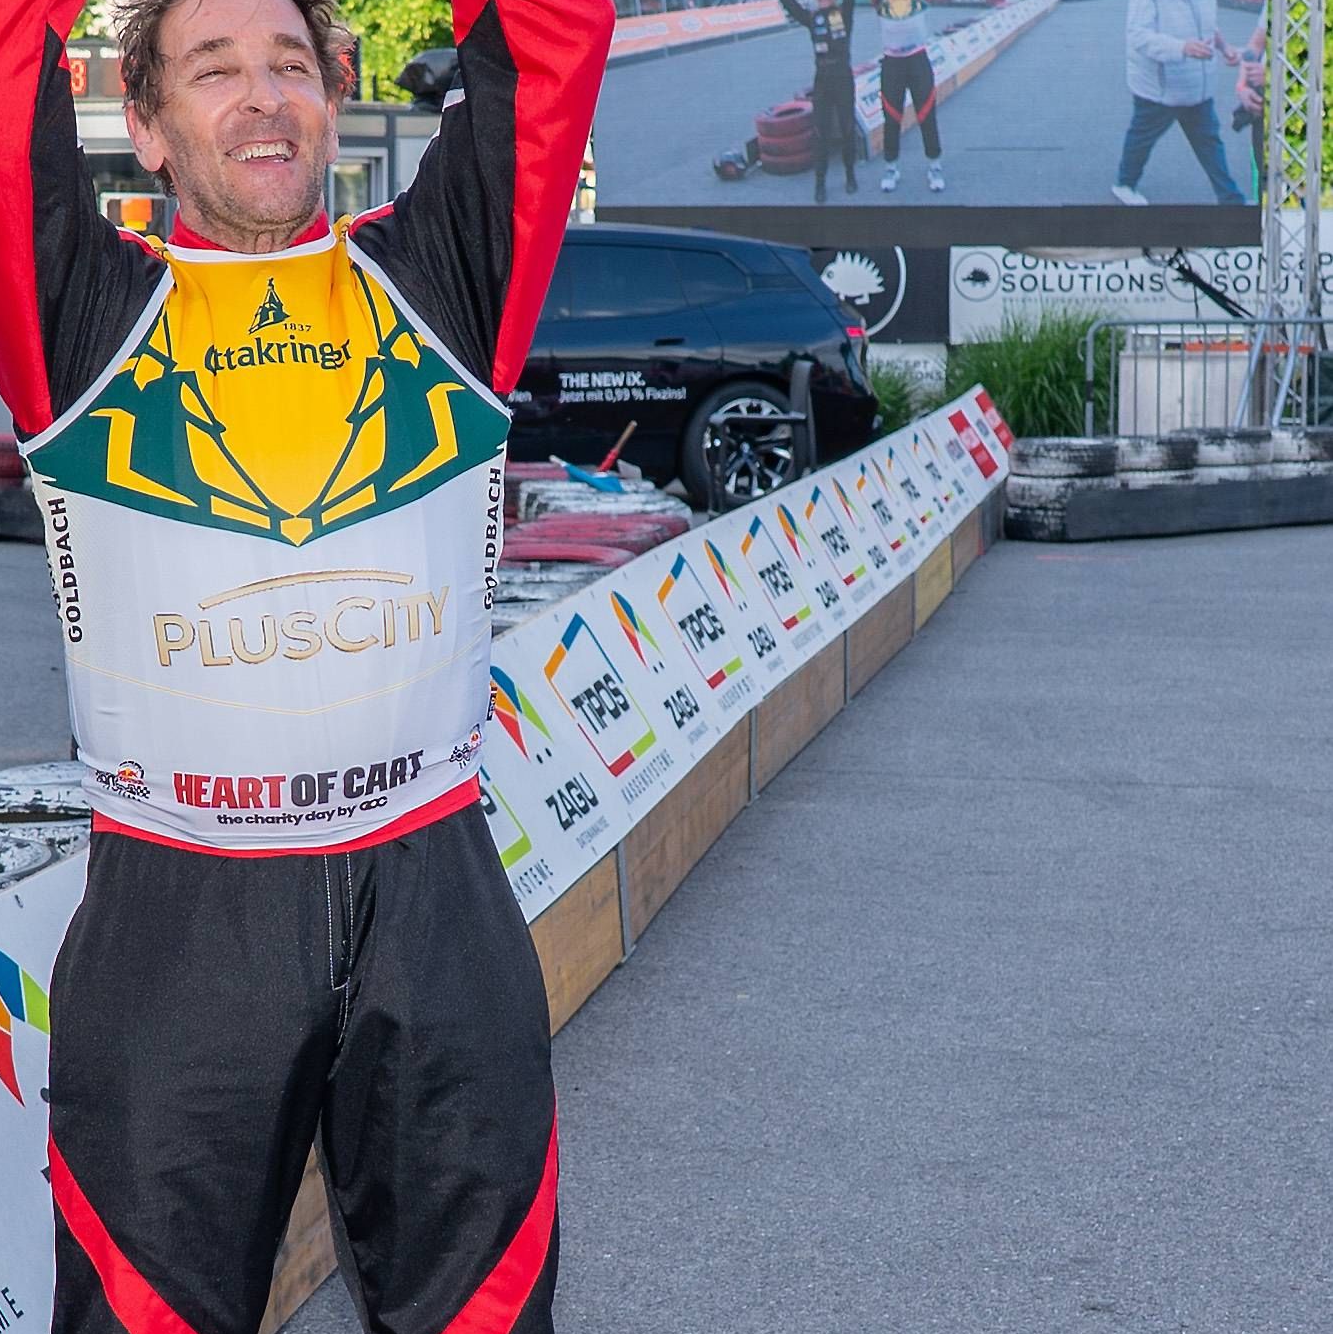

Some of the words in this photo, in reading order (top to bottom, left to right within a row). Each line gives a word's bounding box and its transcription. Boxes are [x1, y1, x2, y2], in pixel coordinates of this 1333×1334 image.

[1002, 273, 1165, 293] SOLUTIONS
[283, 322, 312, 332] 1837
[558, 372, 590, 388] THE
[591, 371, 625, 387] NEW
[47, 497, 83, 643] GOLDBACH
[173, 771, 287, 809] HEART
[290, 770, 339, 807] OF
[343, 749, 425, 799] CART
[546, 771, 601, 832] ZAGU
[217, 814, 244, 825] the
[244, 813, 303, 826] charity
[305, 809, 335, 822] day
[337, 804, 358, 818] by
